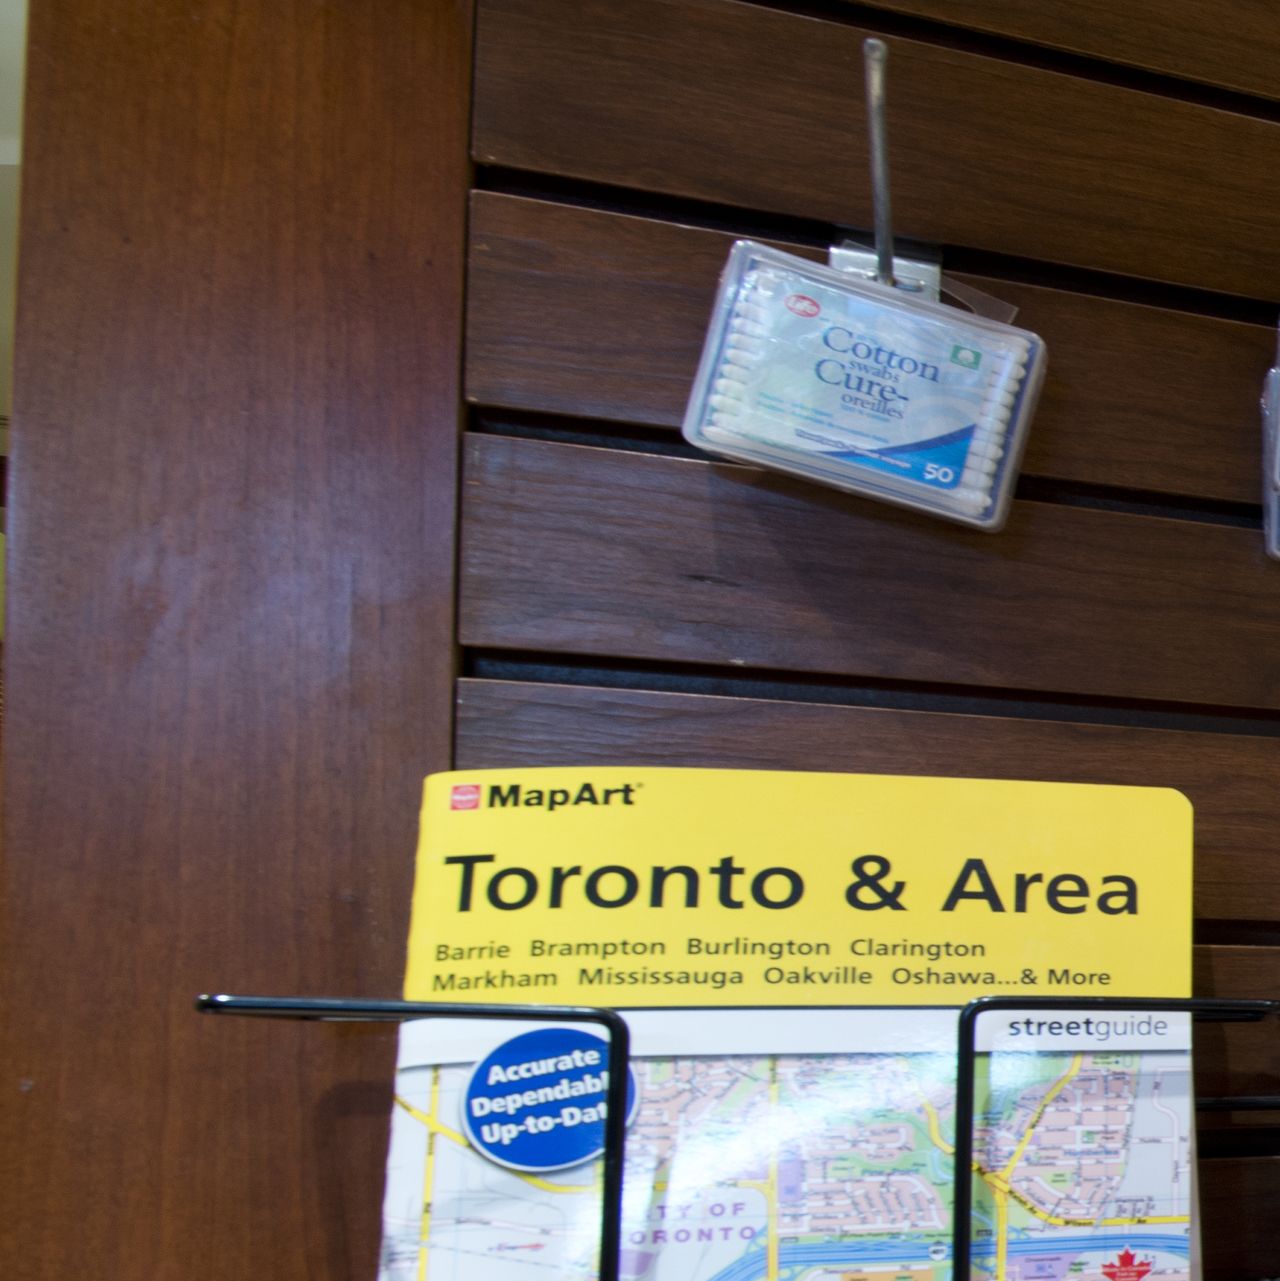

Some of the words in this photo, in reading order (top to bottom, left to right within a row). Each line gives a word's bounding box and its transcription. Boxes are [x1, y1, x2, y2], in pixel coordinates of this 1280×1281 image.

[822, 324, 940, 383] Cotton
[815, 357, 909, 402] Cure-
[848, 356, 901, 384] swabs
[841, 391, 905, 420] oreilles
[923, 463, 954, 483] 50
[488, 783, 636, 811] MapArt
[444, 854, 804, 912] Toronto
[845, 854, 908, 911] &
[941, 858, 1139, 915] Area
[436, 941, 511, 961] Barrie
[530, 938, 666, 960] Brampton
[687, 938, 831, 960] Burlington
[850, 939, 986, 961] Clarington
[432, 969, 558, 992] Markham
[578, 967, 744, 988] Mississauga
[764, 967, 873, 986] Oakville
[1048, 969, 1111, 986] More
[1009, 1015, 1168, 1041] streetguide
[487, 1049, 600, 1085] Accurate
[471, 1071, 609, 1118] Dependabl
[481, 1101, 608, 1145] Up-to-Dat
